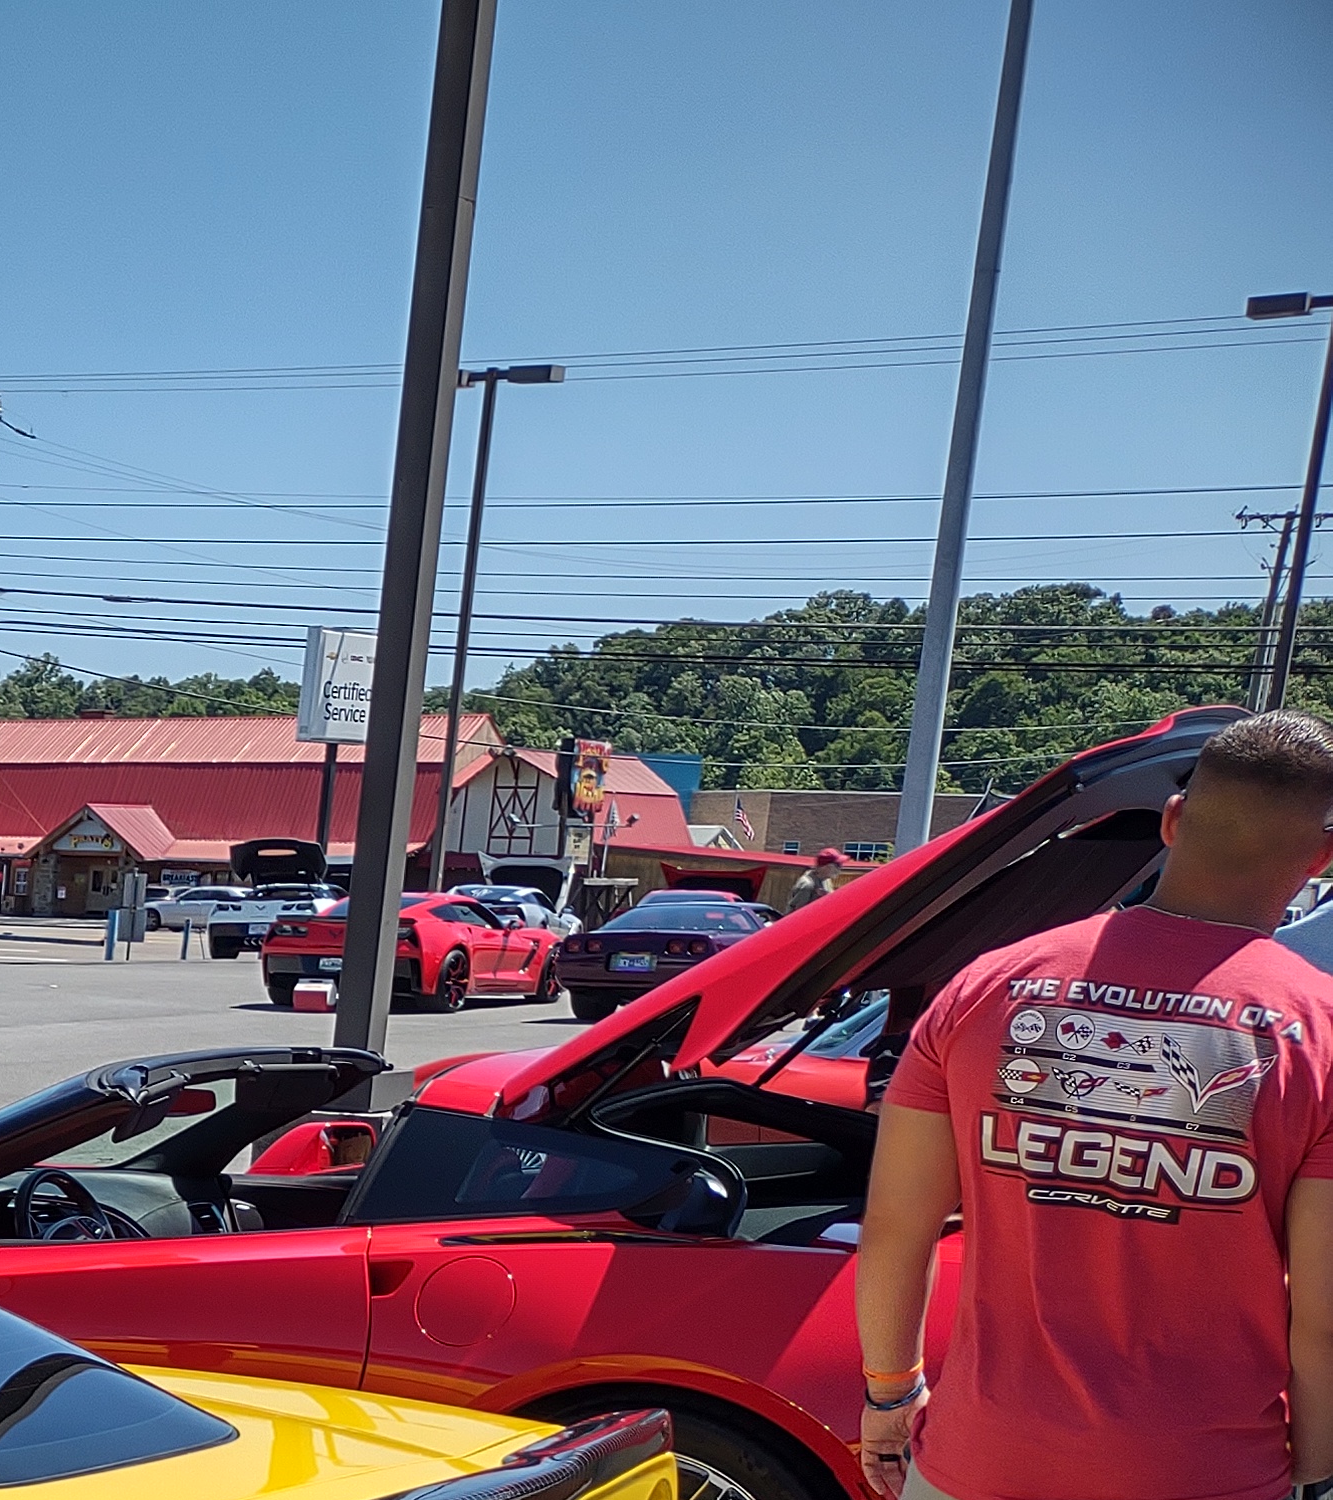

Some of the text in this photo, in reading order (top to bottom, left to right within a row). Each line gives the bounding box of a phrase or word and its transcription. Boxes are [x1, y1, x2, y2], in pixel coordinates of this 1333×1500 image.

[323, 702, 367, 723] Service
[1009, 978, 1305, 1045] THE EVOLUTION OF A
[1014, 1046, 1132, 1071] C1 C2 C3
[1010, 1096, 1025, 1105] C4
[1065, 1104, 1079, 1114] C5
[1185, 1122, 1201, 1131] C7
[983, 1115, 1258, 1200] LEGEND
[1028, 1188, 1172, 1219] CORVETTE
